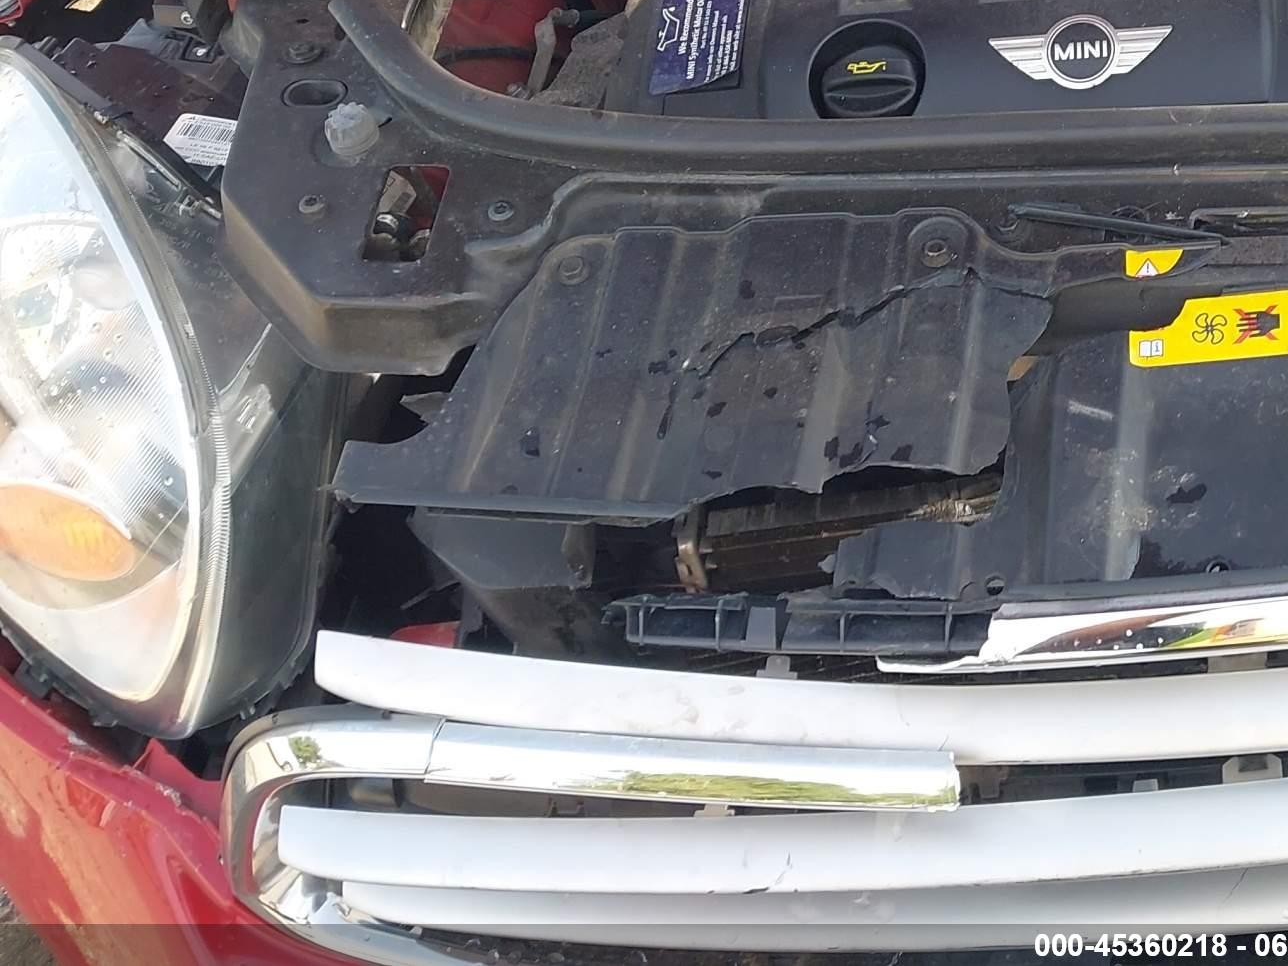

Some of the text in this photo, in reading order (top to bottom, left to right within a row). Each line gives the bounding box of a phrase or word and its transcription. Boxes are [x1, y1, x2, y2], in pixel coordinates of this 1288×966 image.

[678, 0, 693, 55] We Recommend
[693, 7, 703, 27] Motor
[689, 29, 702, 60] Synthetic
[1054, 40, 1108, 61] MINI
[686, 61, 696, 80] MINI
